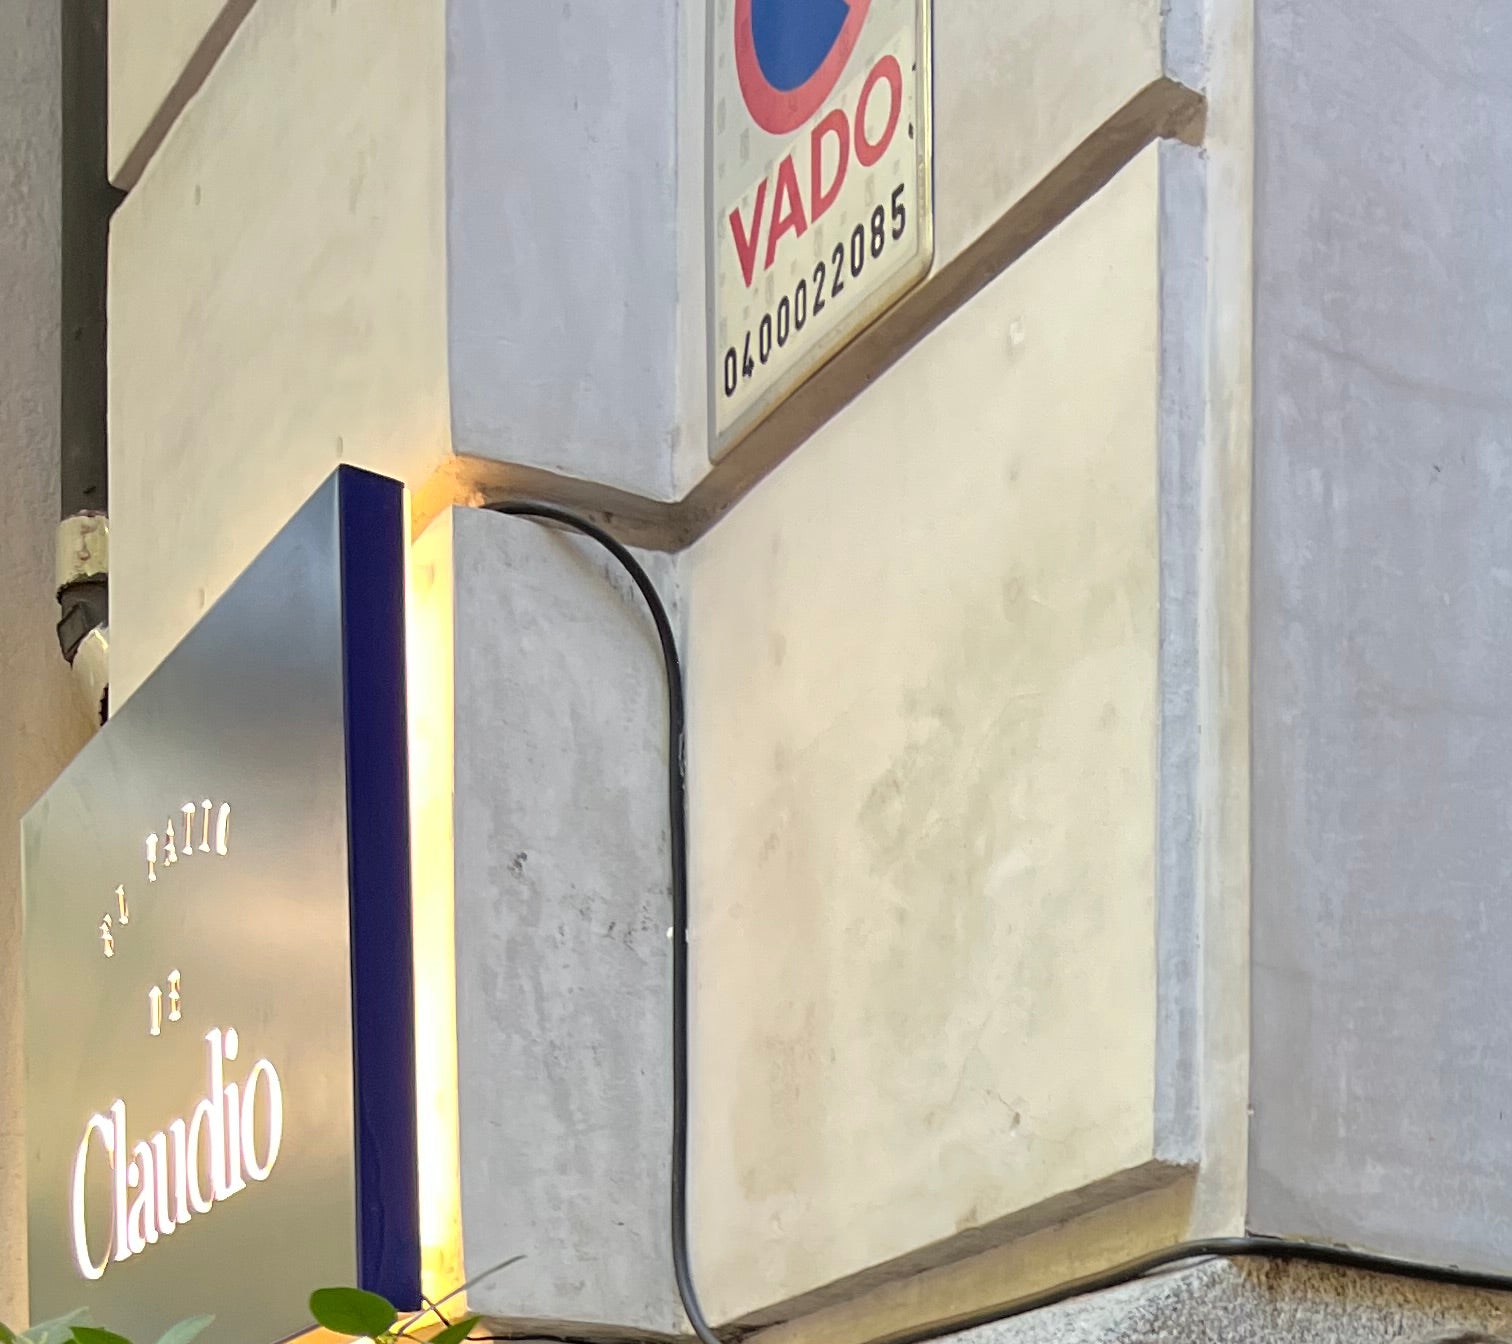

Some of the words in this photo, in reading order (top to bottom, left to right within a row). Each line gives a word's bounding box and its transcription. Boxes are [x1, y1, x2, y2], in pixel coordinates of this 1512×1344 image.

[729, 54, 903, 289] VADO
[723, 183, 906, 398] 0400022085
[72, 1026, 284, 1280] Claudio
